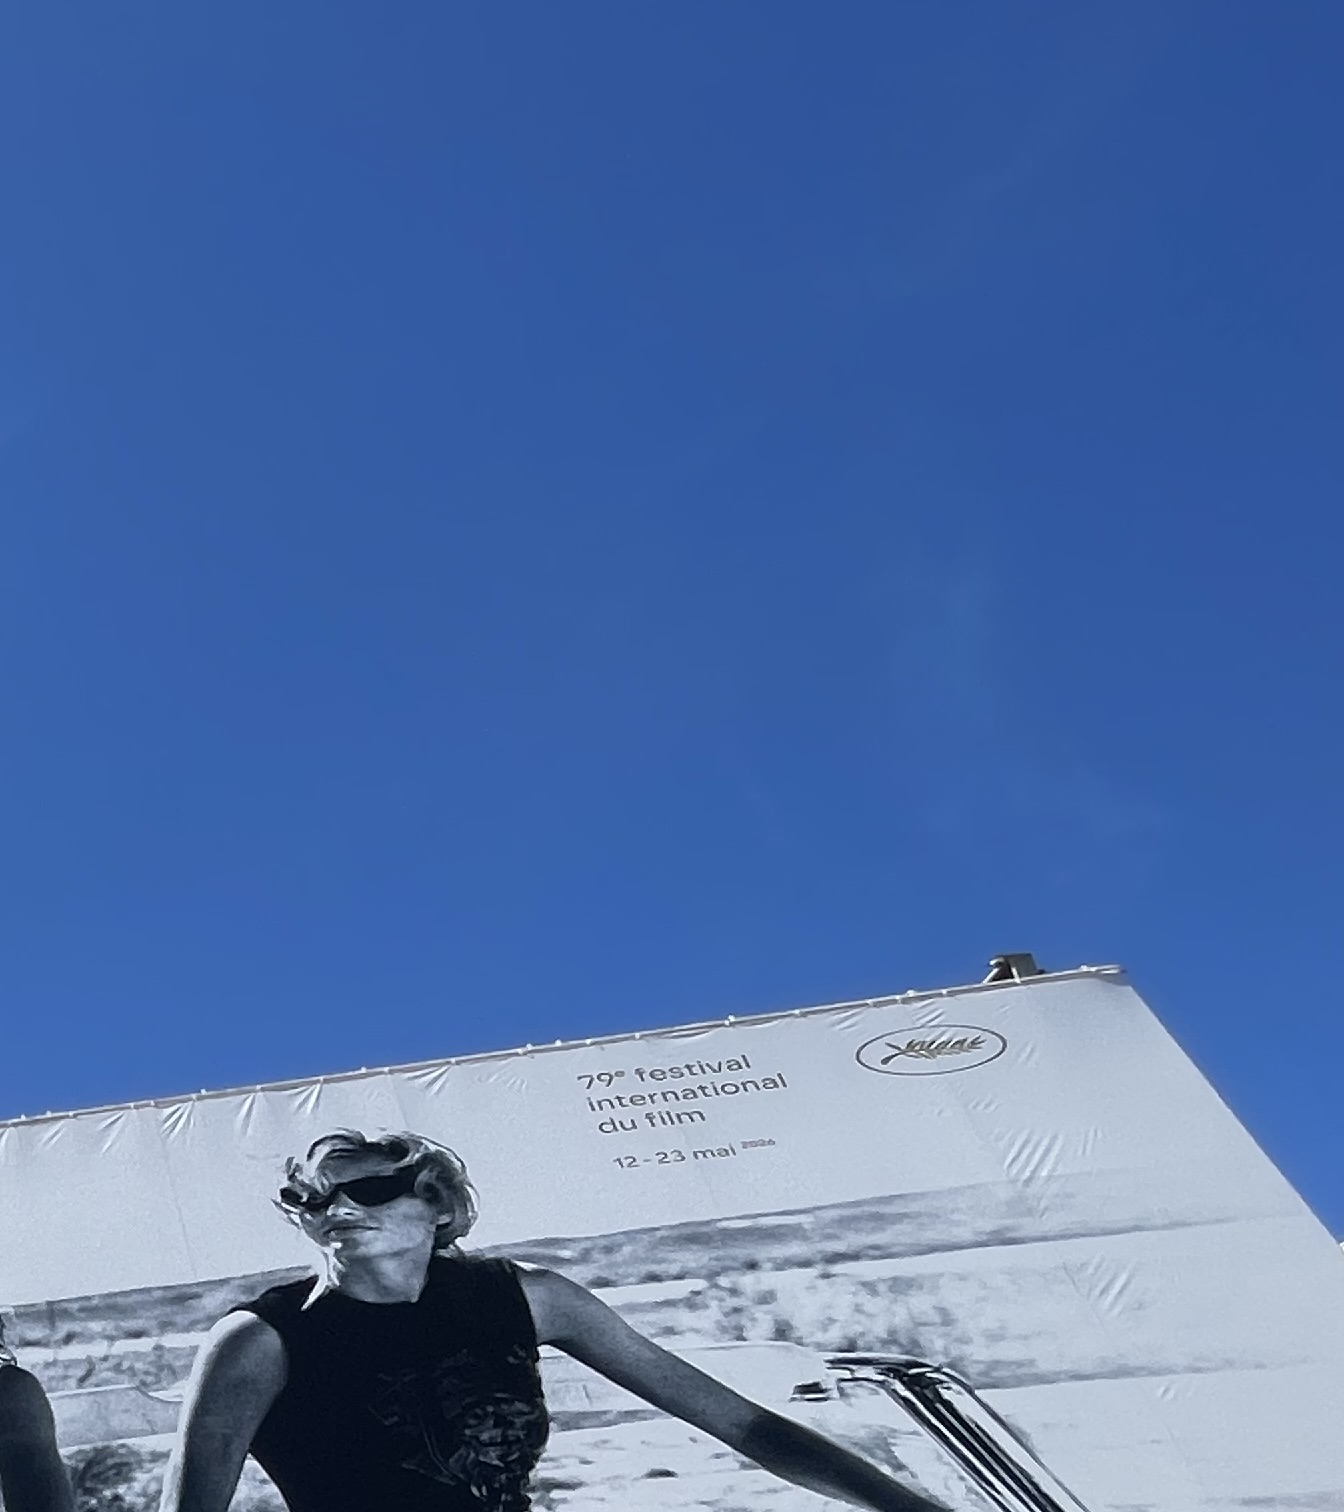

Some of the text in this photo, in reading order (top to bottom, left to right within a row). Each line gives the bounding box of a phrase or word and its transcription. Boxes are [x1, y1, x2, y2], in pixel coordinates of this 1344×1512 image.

[635, 1055, 751, 1082] festival
[587, 1073, 788, 1112] international
[598, 1109, 706, 1134] du film
[693, 1144, 736, 1161] mai
